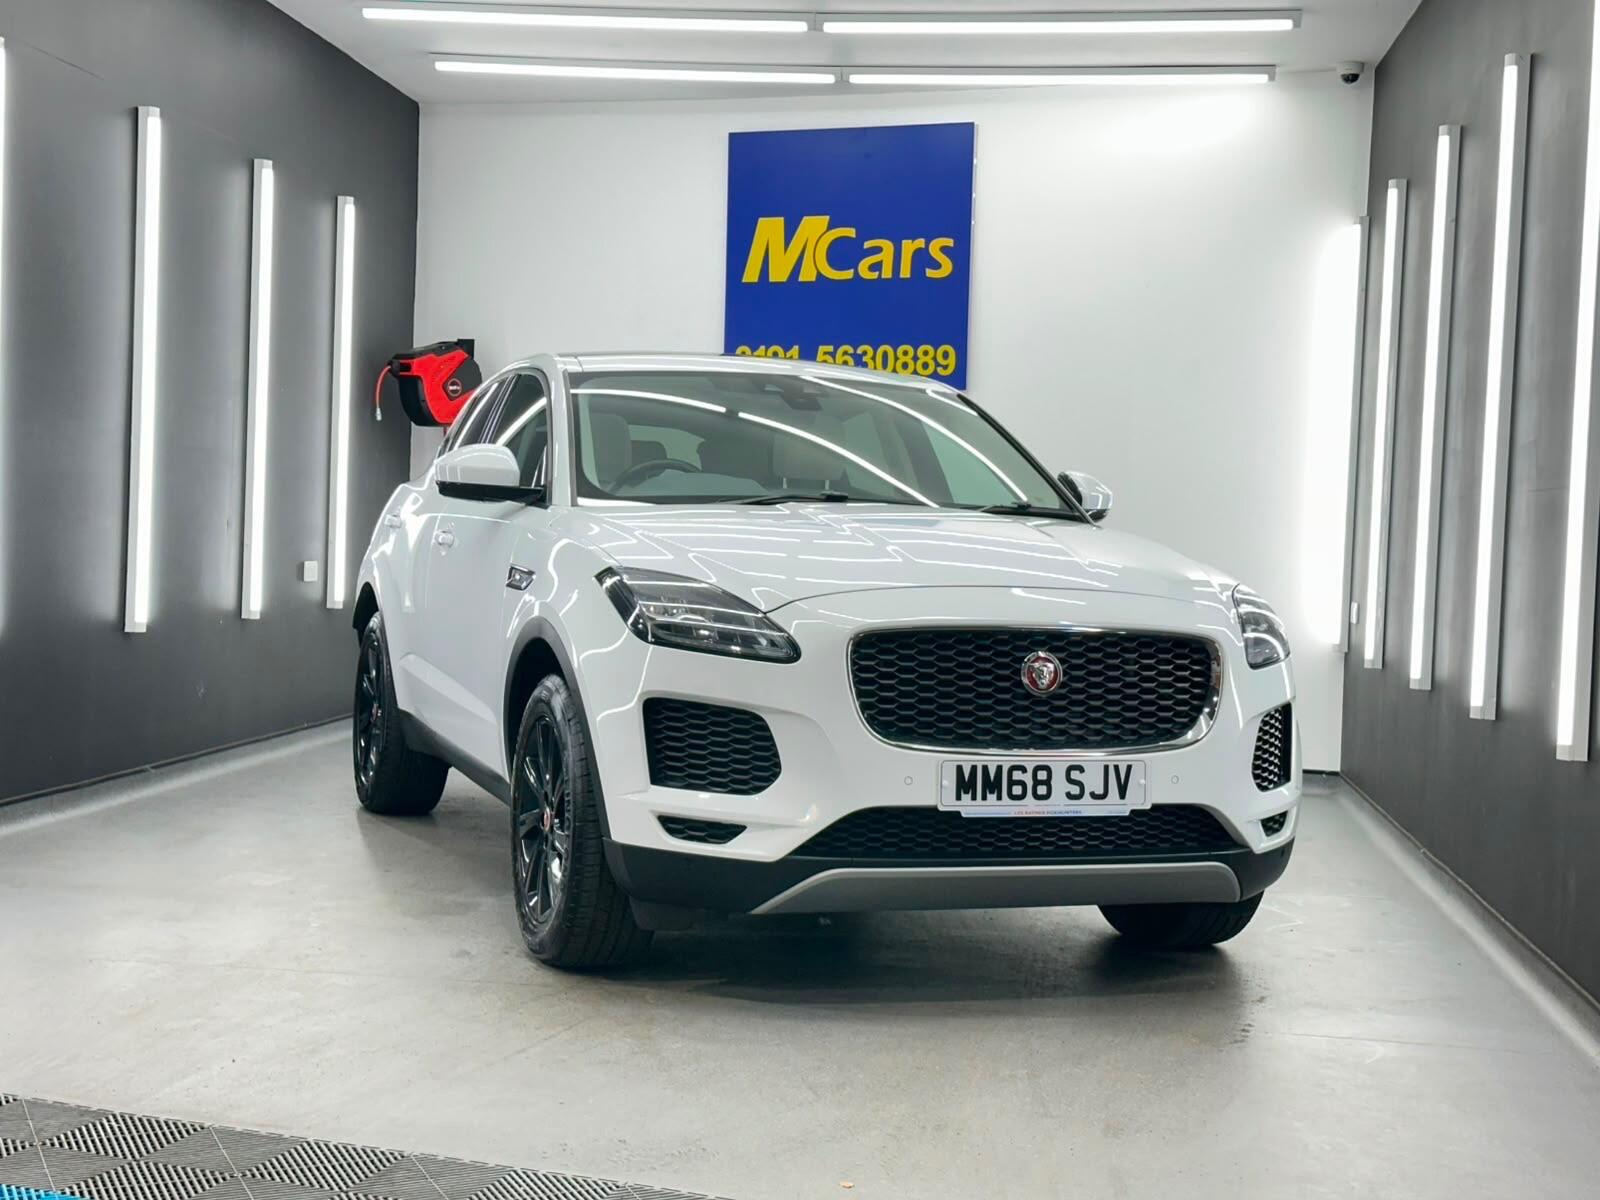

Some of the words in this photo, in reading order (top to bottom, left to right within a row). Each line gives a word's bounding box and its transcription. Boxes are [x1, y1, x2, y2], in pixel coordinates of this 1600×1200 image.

[816, 345, 956, 376] 5630889
[955, 764, 1053, 802] MM68
[1065, 764, 1133, 801] SJV
